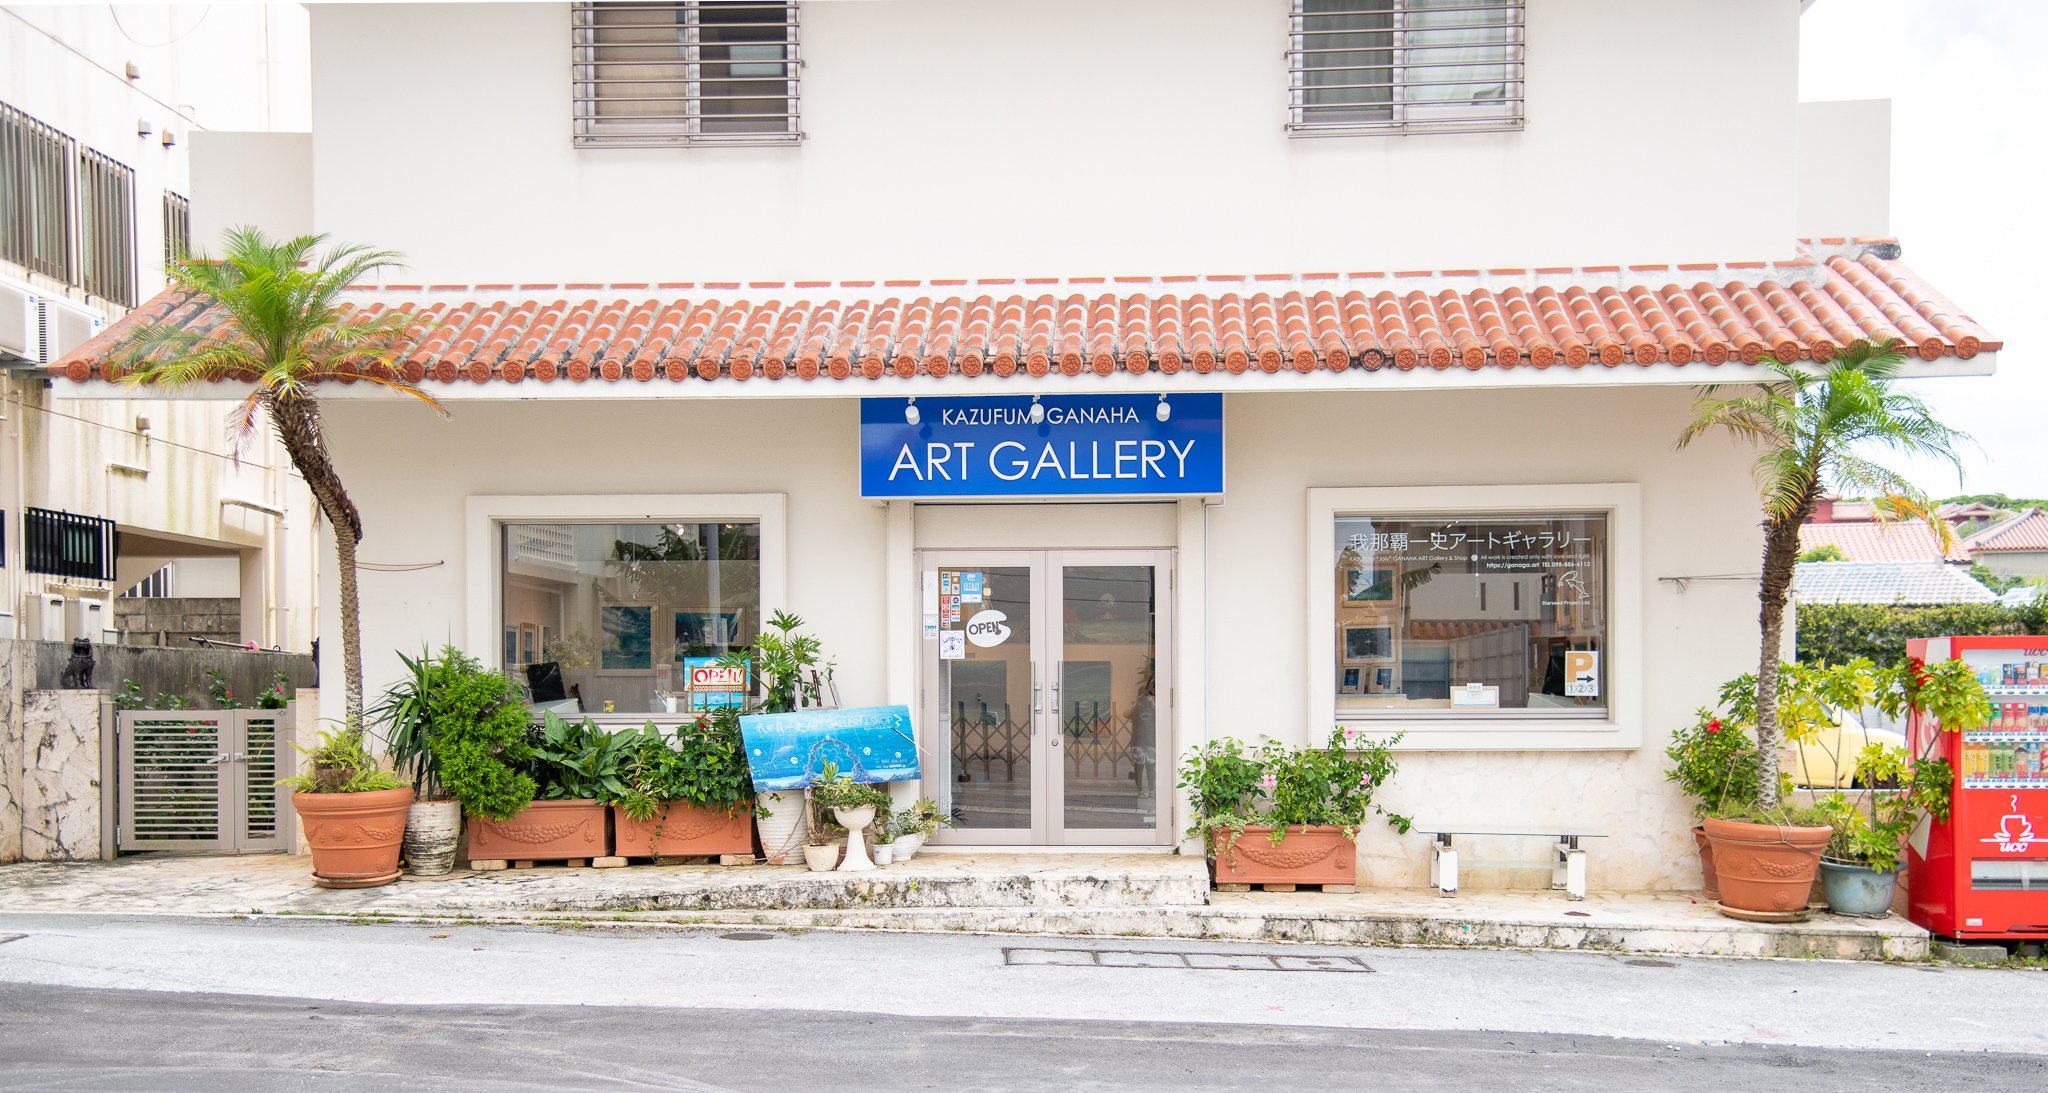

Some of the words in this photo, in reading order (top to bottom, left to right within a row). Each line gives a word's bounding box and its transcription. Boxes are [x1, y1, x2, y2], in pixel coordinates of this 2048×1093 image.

[942, 408, 1041, 426] KAZUFUM
[1046, 406, 1140, 425] GANAHA
[888, 442, 975, 481] ART
[988, 439, 1196, 481] GALLERY
[1349, 530, 1591, 552] 我那覇一史アートギャラリー
[969, 621, 1000, 635] OPEN
[1567, 653, 1594, 682] P
[870, 714, 893, 726] SHOP
